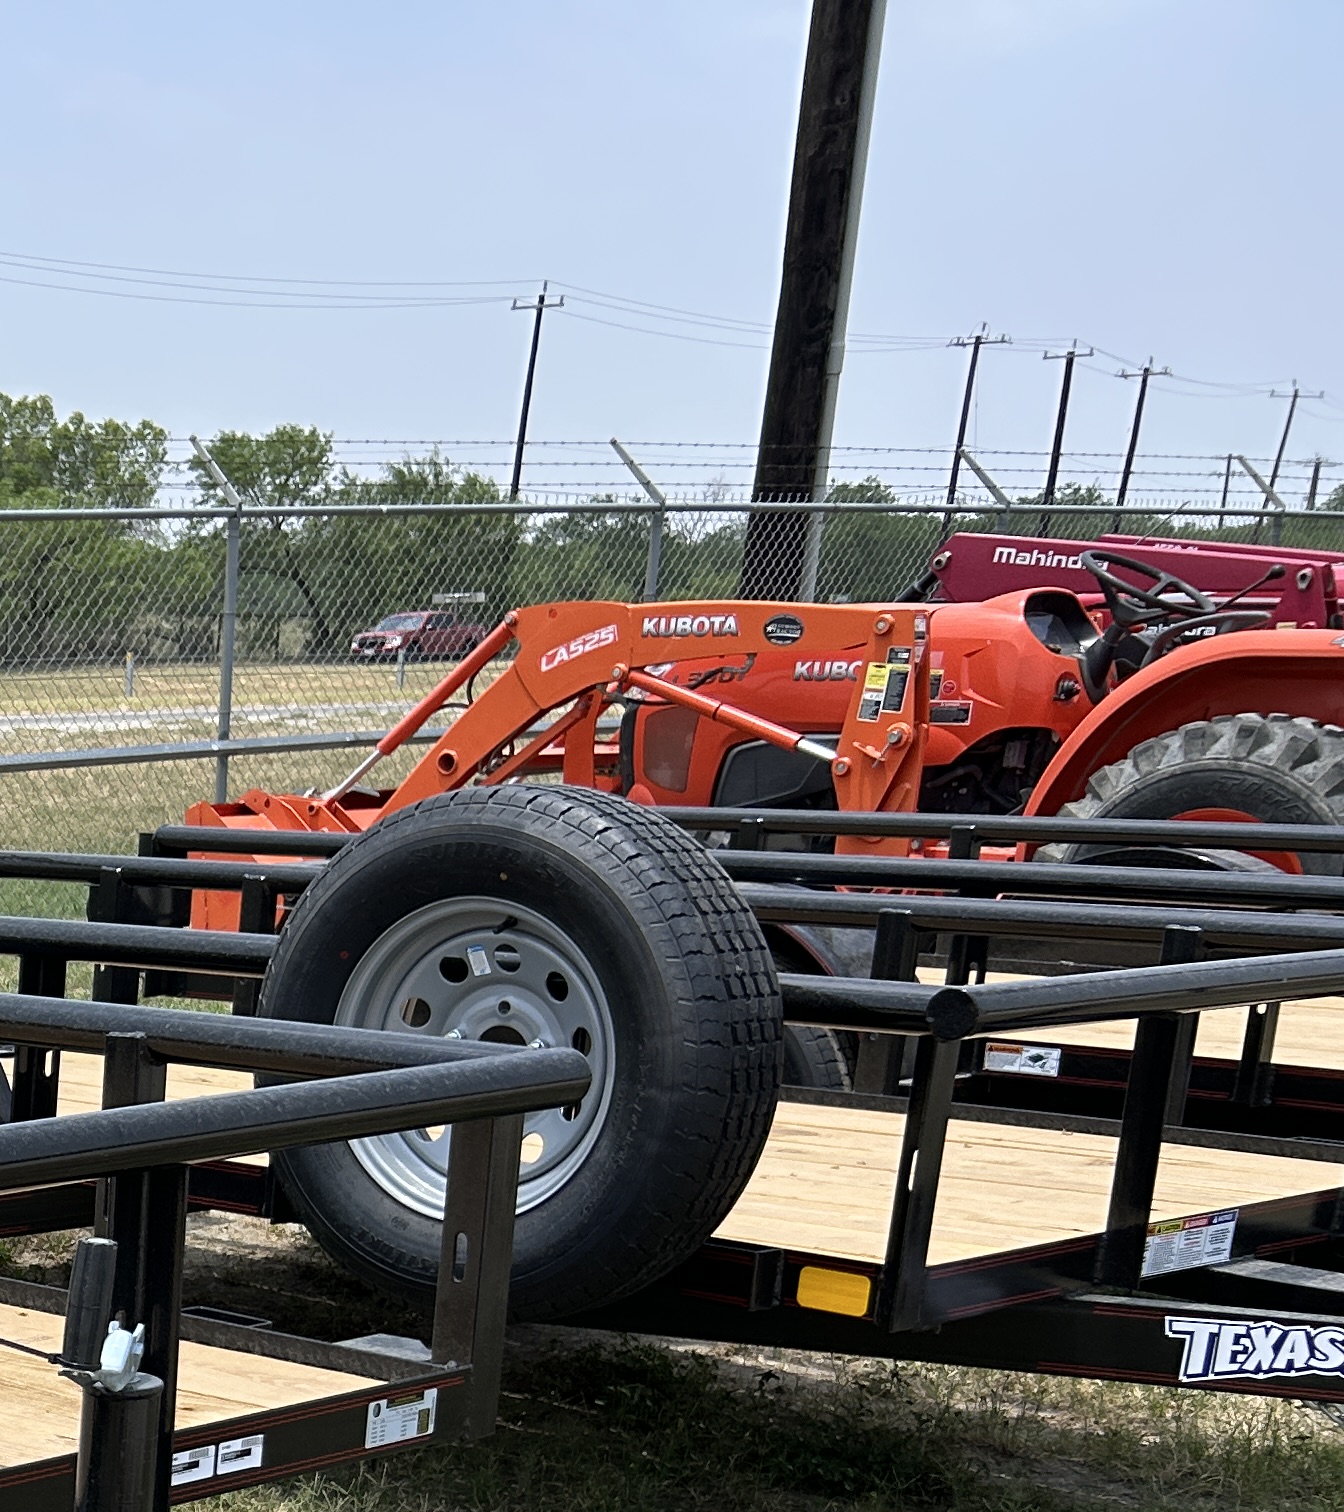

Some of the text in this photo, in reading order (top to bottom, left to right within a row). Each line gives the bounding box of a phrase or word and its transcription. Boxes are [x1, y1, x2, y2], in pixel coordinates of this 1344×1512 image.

[992, 546, 1110, 571] Mahinda
[641, 614, 739, 638] KUBOTA
[540, 625, 618, 672] LA525
[1166, 1317, 1344, 1380] TEXAS
